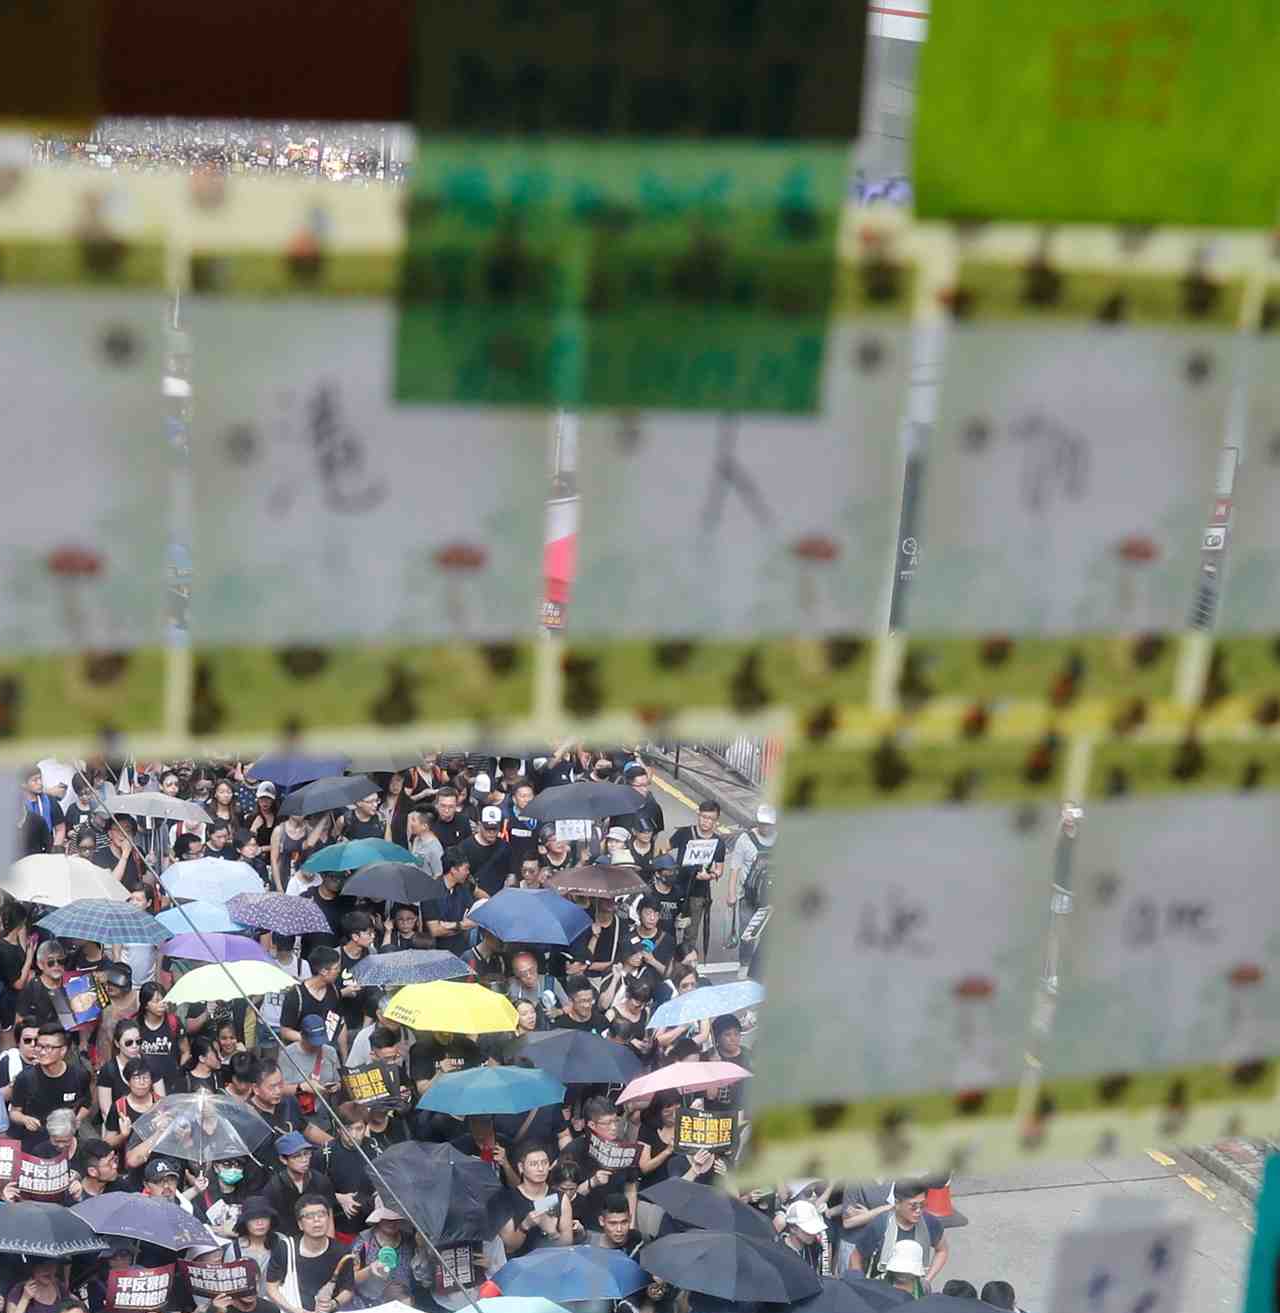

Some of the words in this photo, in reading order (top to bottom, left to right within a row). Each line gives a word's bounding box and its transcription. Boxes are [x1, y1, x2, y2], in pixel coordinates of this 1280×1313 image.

[681, 1116, 733, 1130] 全面撤回
[116, 1273, 169, 1292] 平反暴動
